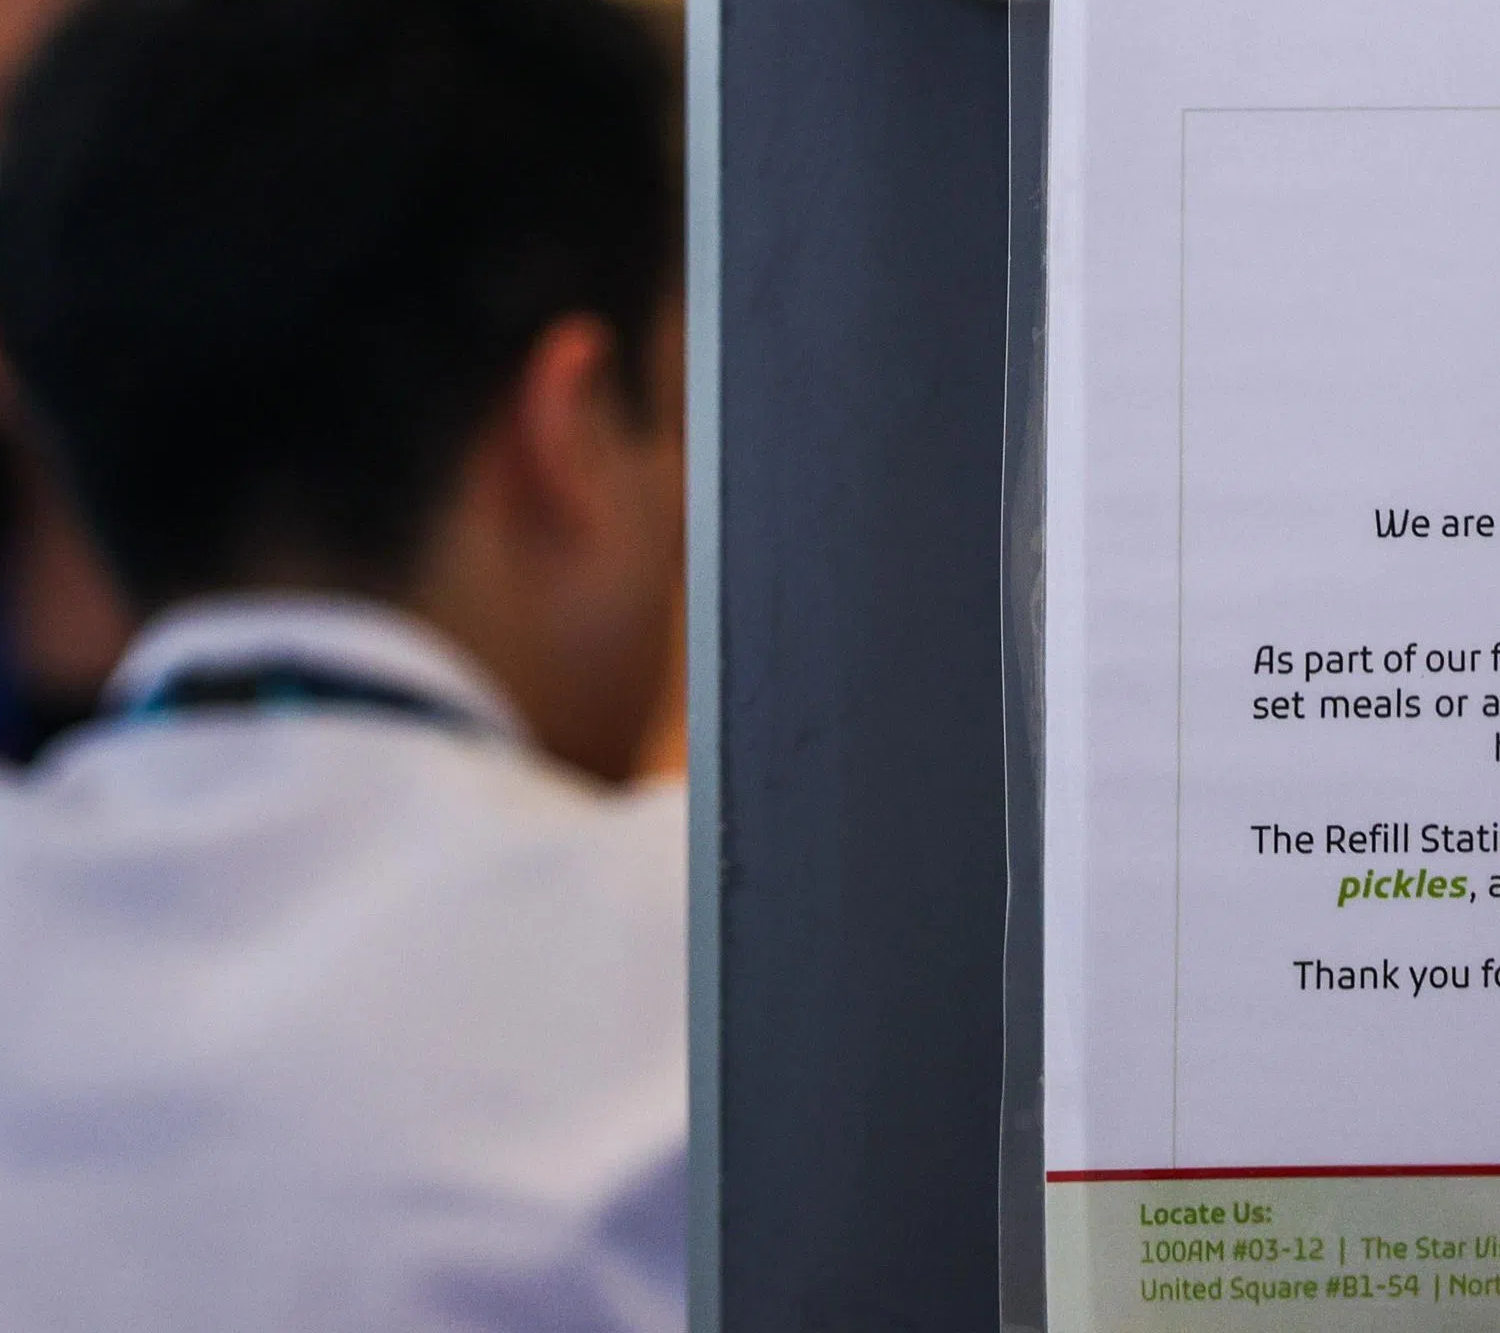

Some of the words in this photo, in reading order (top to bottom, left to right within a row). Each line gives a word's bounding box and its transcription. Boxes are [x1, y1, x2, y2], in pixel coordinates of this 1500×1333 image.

[1375, 509, 1430, 538] We
[1442, 514, 1495, 538] are
[1254, 645, 1293, 675] As
[1305, 646, 1373, 682] part
[1384, 642, 1417, 673] of
[1426, 650, 1481, 673] our
[1251, 824, 1314, 854] The
[1326, 823, 1409, 854] Refill
[1140, 1203, 1225, 1226] Locate
[1233, 1201, 1273, 1224] Us:
[1141, 1239, 1224, 1263] 100AM
[1232, 1237, 1324, 1263] #03-12
[1361, 1236, 1408, 1260] The
[1415, 1236, 1467, 1259] Star
[1140, 1276, 1223, 1302] United
[1230, 1276, 1318, 1305] Square
[1325, 1274, 1420, 1298] #B1-54
